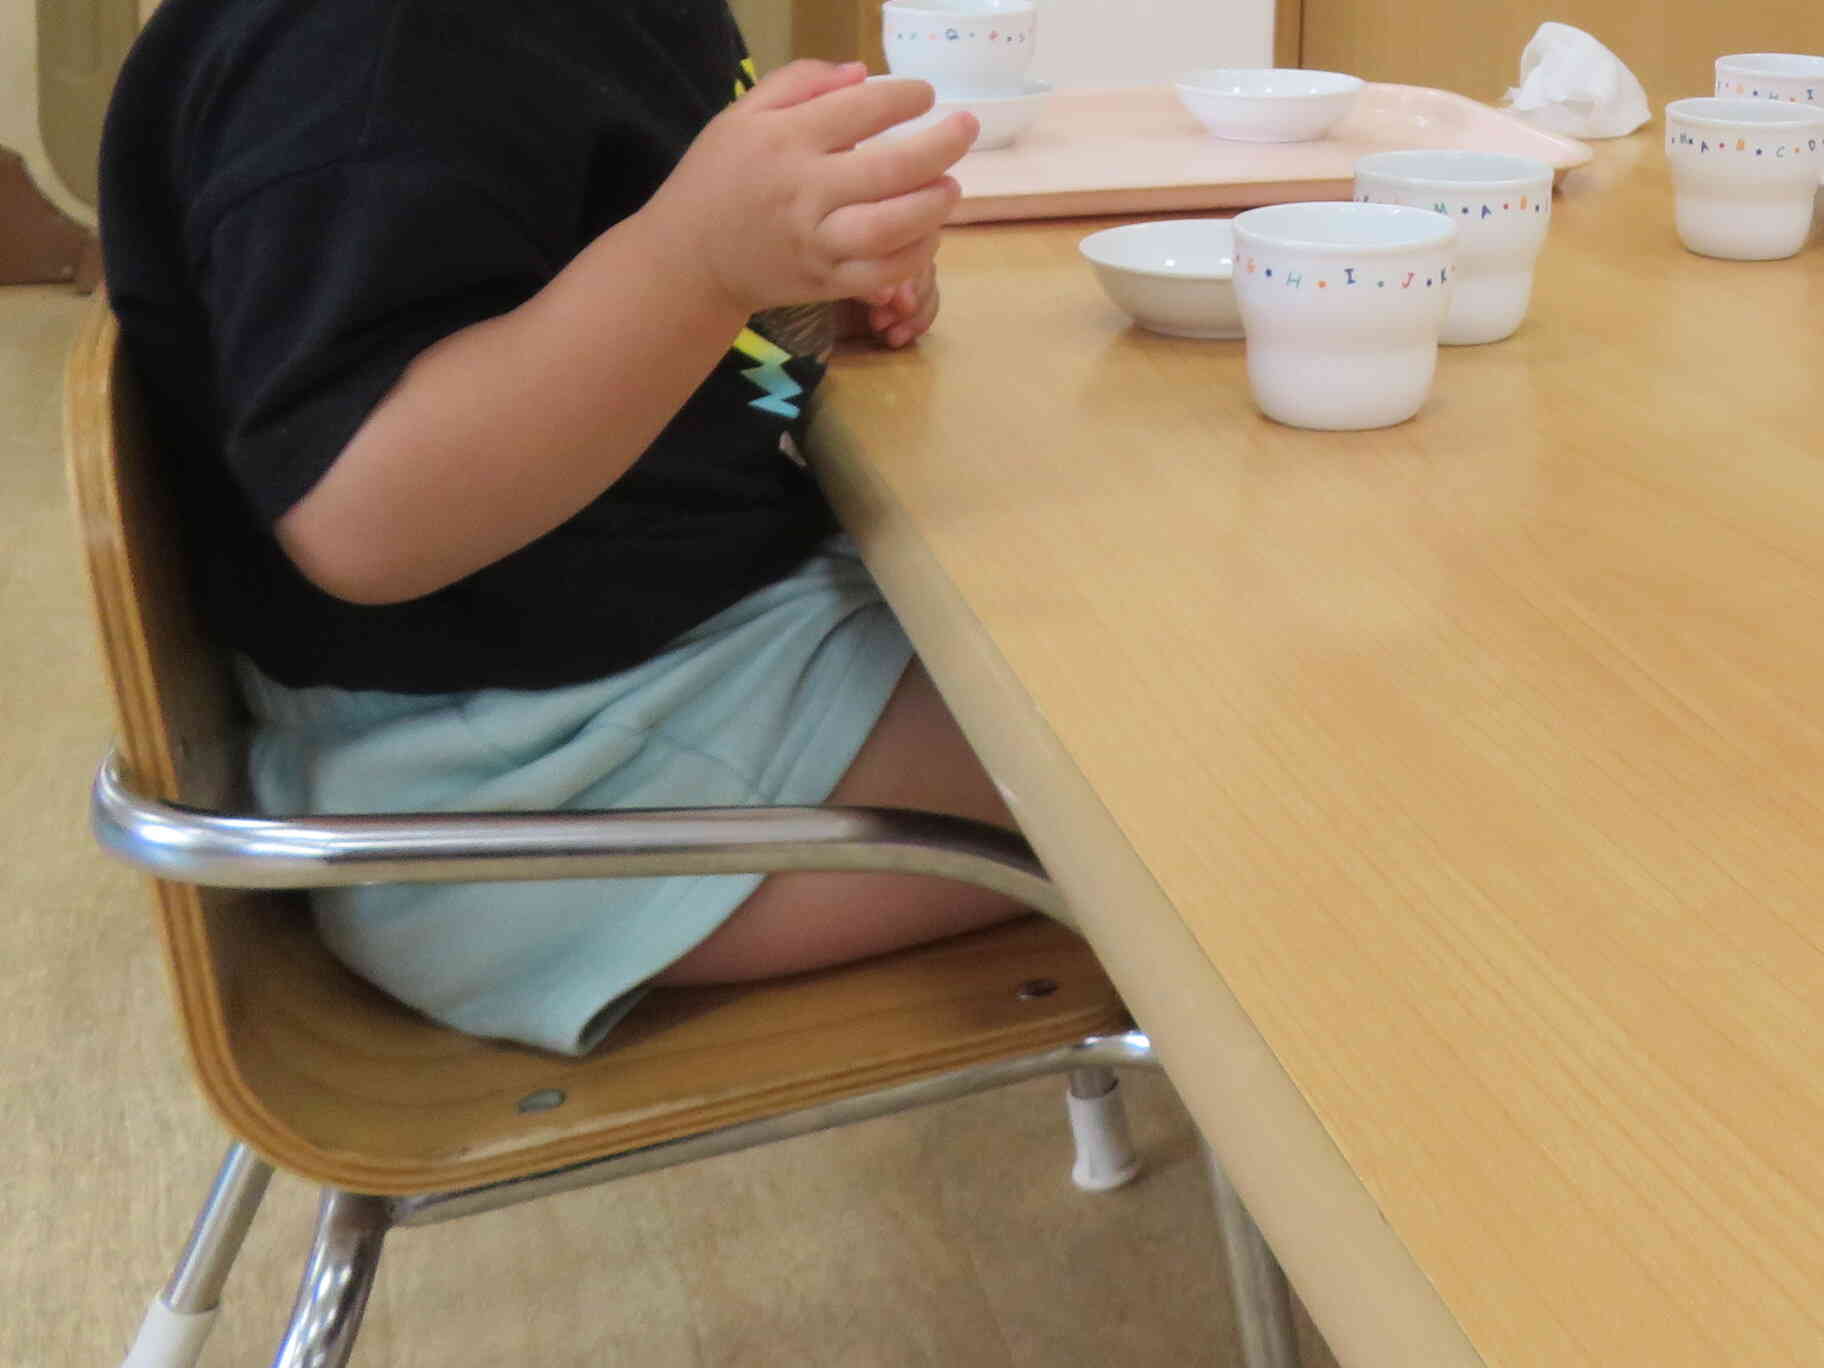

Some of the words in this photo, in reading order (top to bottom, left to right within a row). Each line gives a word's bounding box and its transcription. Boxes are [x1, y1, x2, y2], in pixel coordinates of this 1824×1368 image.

[1701, 140, 1710, 153] A
[1344, 268, 1356, 285] I
[1401, 272, 1416, 288] J
